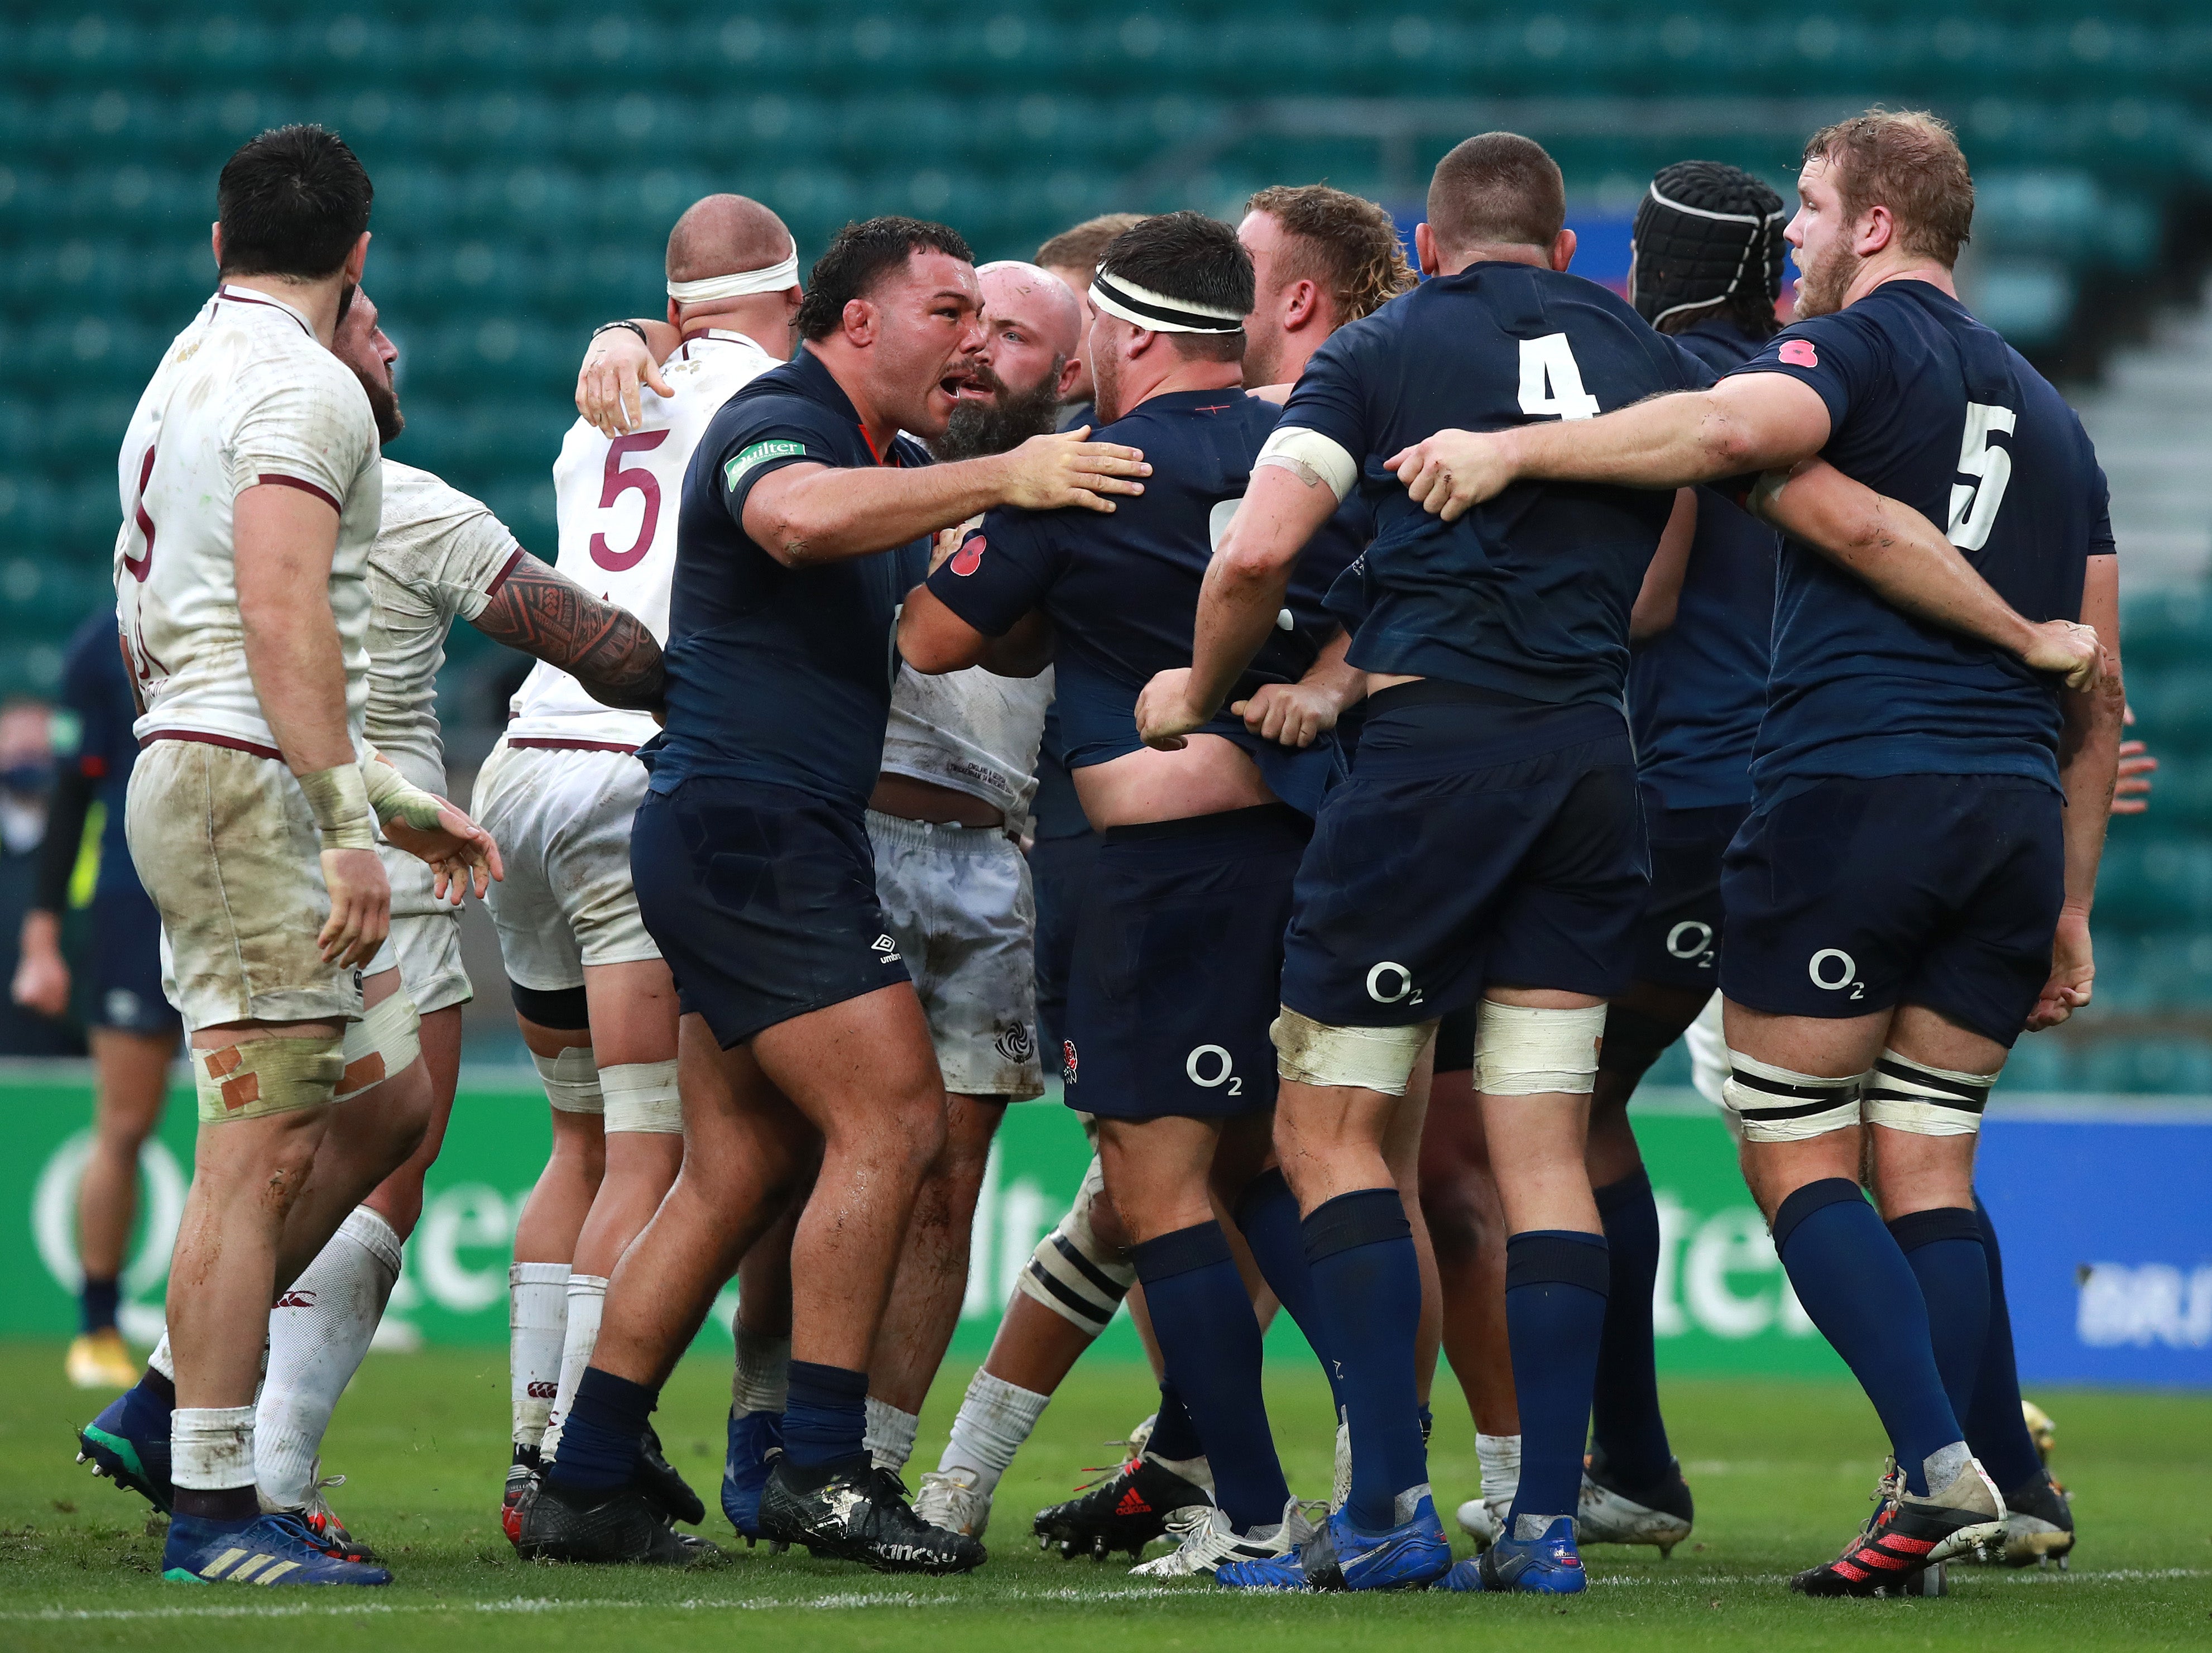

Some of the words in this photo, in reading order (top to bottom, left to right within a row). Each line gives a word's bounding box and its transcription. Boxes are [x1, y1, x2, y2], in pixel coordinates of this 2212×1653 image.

[1517, 333, 1601, 421] 4
[589, 429, 670, 572] 5
[732, 442, 798, 474] Quilter
[1945, 401, 2016, 551] 5
[1115, 1504, 1153, 1516] adidas
